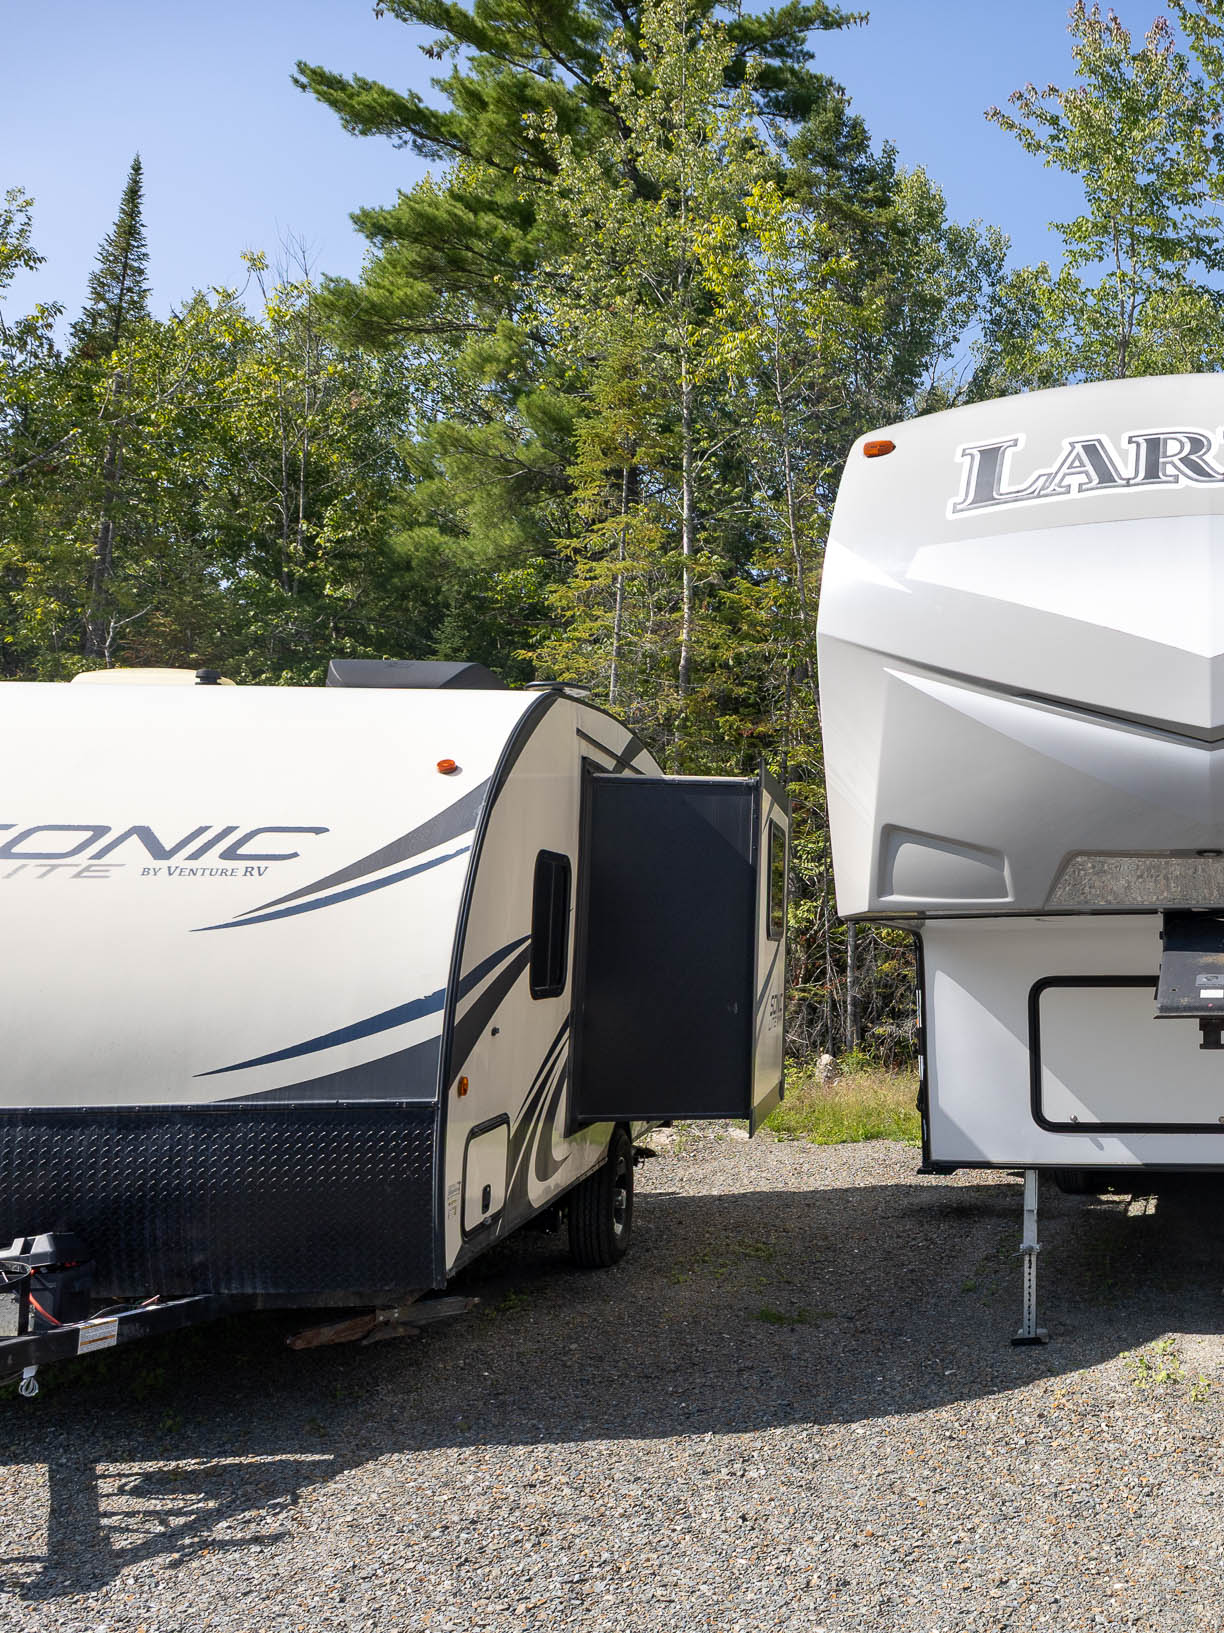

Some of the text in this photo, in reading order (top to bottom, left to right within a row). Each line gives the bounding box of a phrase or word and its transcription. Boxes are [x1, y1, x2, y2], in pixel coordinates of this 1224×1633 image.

[0, 823, 330, 861] ONIC
[141, 866, 269, 877] BY VENTURE RV
